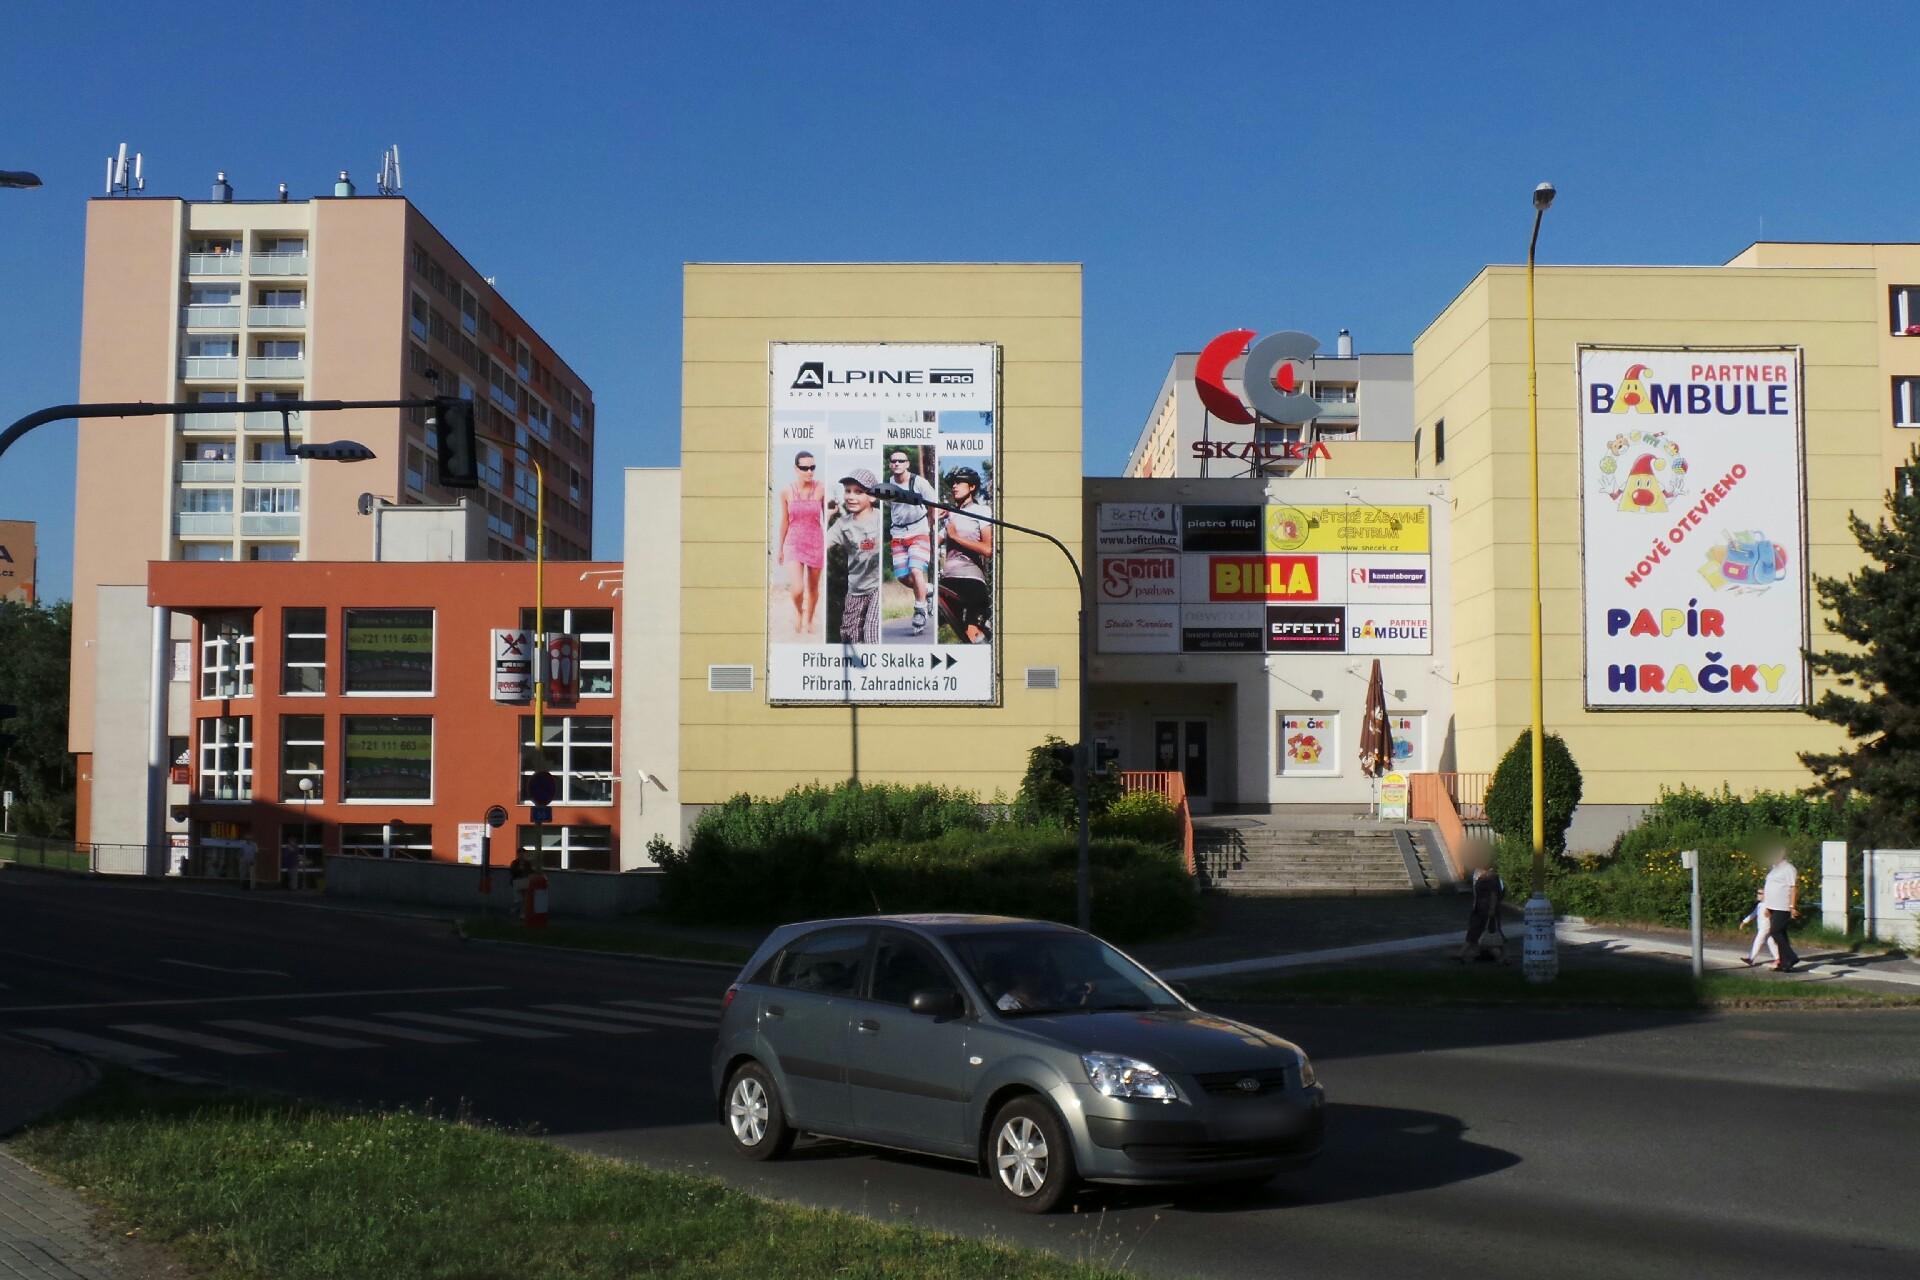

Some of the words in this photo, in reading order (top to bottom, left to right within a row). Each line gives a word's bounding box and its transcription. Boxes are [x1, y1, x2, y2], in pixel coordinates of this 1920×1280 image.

[791, 362, 924, 389] ALPINE
[940, 375, 972, 384] PRO
[1691, 364, 1788, 382] PARTNER
[1590, 372, 1789, 416] BAMBULE
[783, 428, 789, 438] K
[792, 425, 814, 439] VODĚ
[887, 428, 899, 439] NA
[900, 428, 932, 439] BRUSLE
[834, 439, 846, 450] NA
[848, 436, 875, 450] VÝLET
[946, 440, 958, 450] NA
[961, 440, 984, 451] KOLO
[1192, 441, 1332, 460] SKALKA
[1231, 519, 1257, 529] filipi
[1625, 538, 1671, 588] NOVĚ
[1668, 463, 1747, 543] OTEVŘENO
[1103, 559, 1173, 598] Spirit
[1215, 563, 1313, 594] BILLA
[1390, 619, 1428, 627] PARTNER
[1607, 598, 1725, 638] PAPÍR
[1352, 623, 1428, 639] BAMBULE
[861, 653, 877, 668] OC
[882, 652, 925, 668] Skalka
[1608, 651, 1786, 694] HRAČKY
[802, 675, 857, 692] Příbram,
[861, 675, 939, 691] Zahradnická
[943, 676, 958, 691] 70
[1282, 717, 1329, 729] HRAČKY
